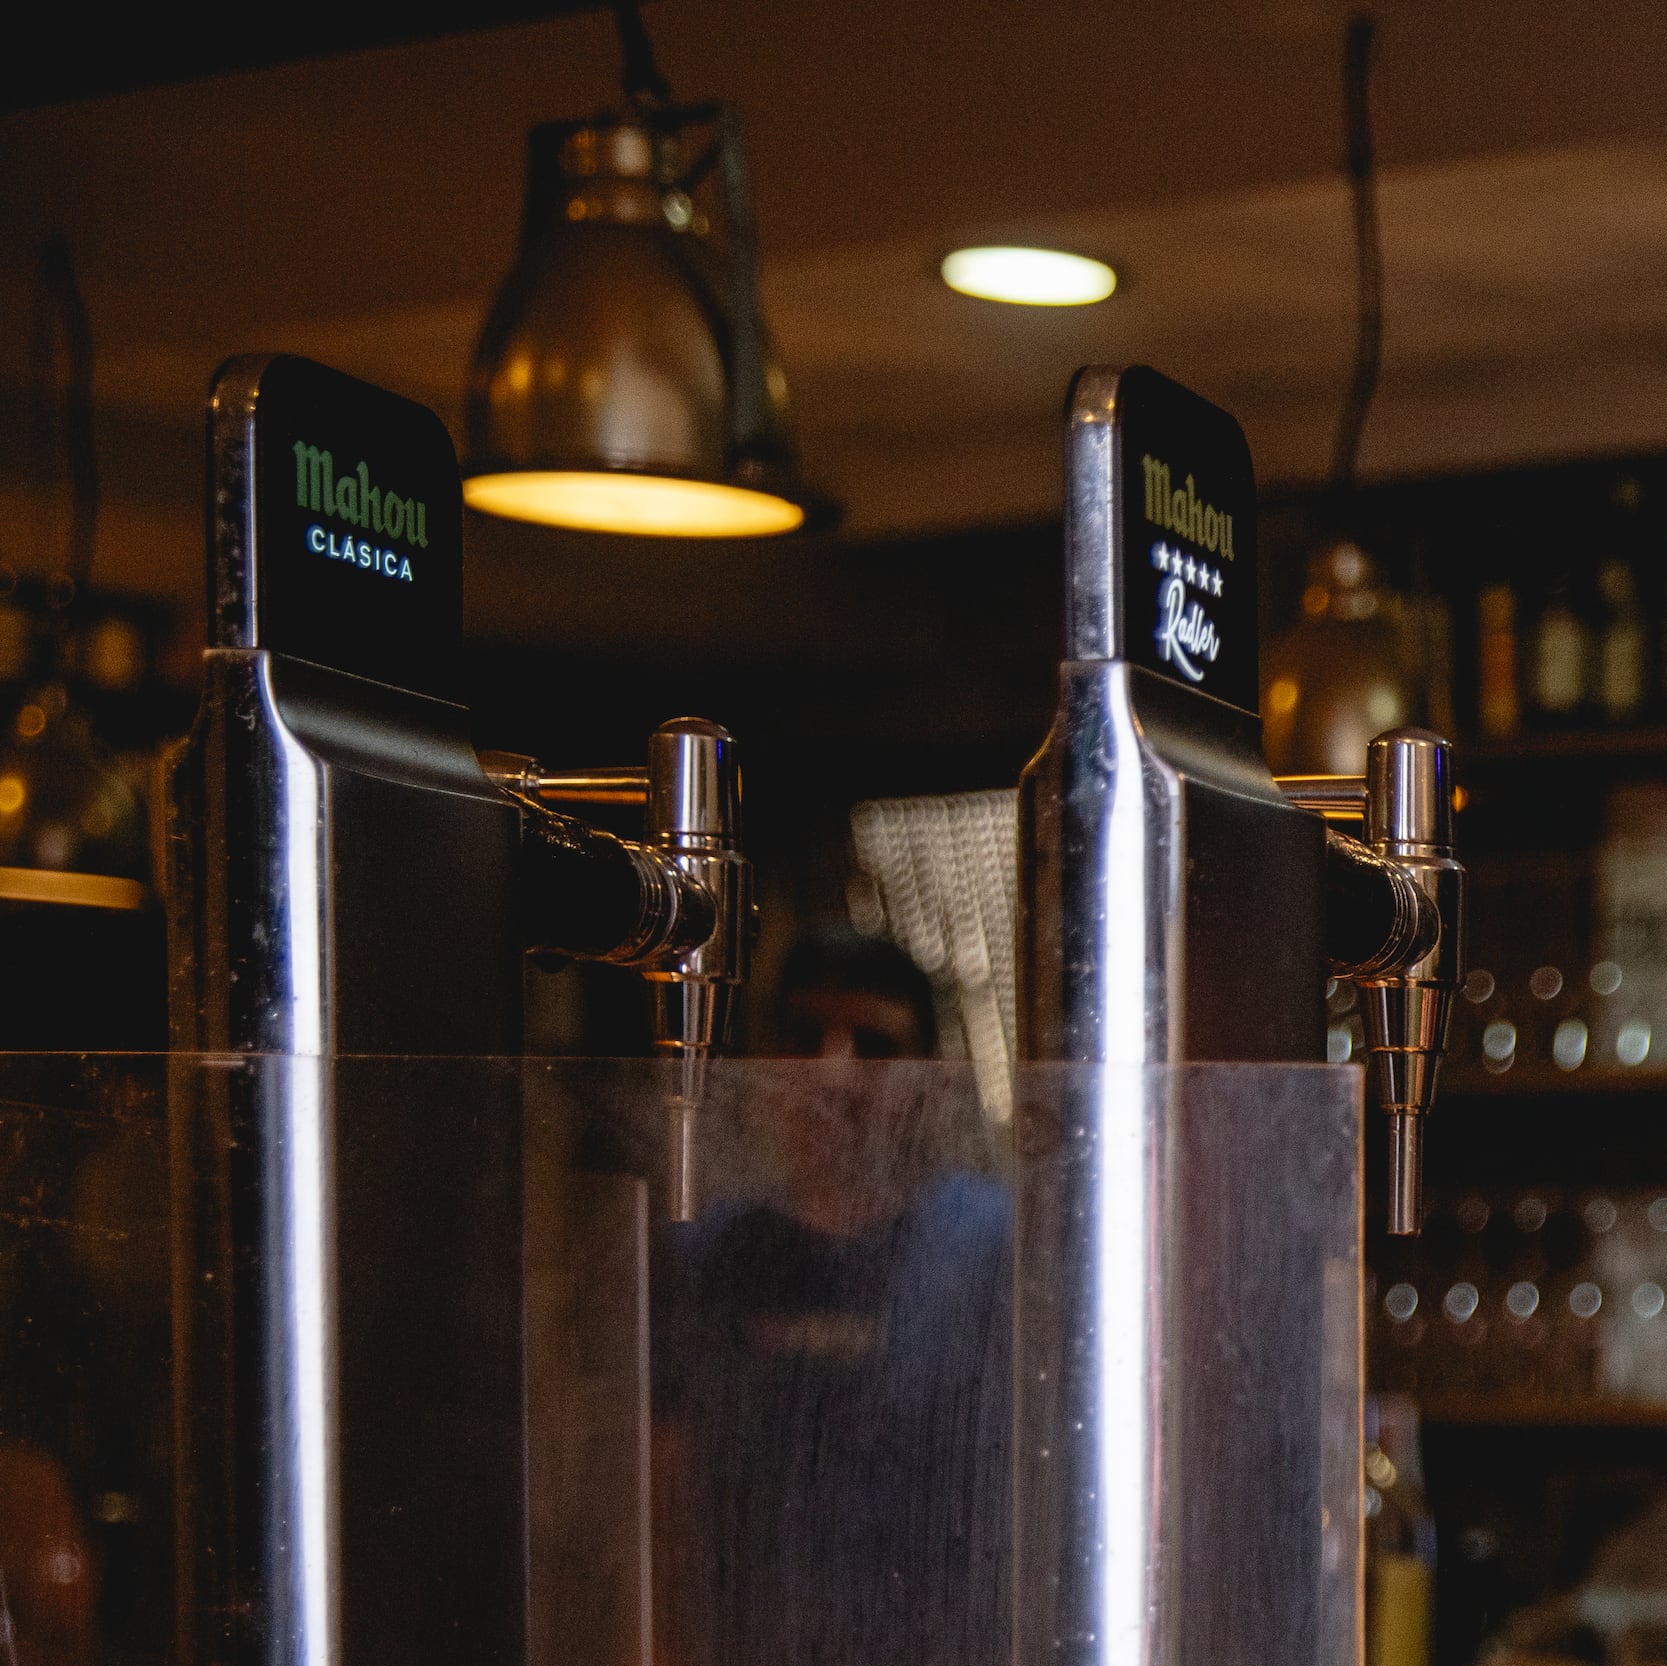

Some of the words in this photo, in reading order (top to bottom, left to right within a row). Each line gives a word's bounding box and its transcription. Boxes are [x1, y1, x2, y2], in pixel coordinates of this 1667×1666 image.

[292, 440, 429, 548] Mahou
[1142, 453, 1234, 562] Mahou
[308, 524, 415, 582] CLÁSICA
[1161, 578, 1220, 681] Radler
